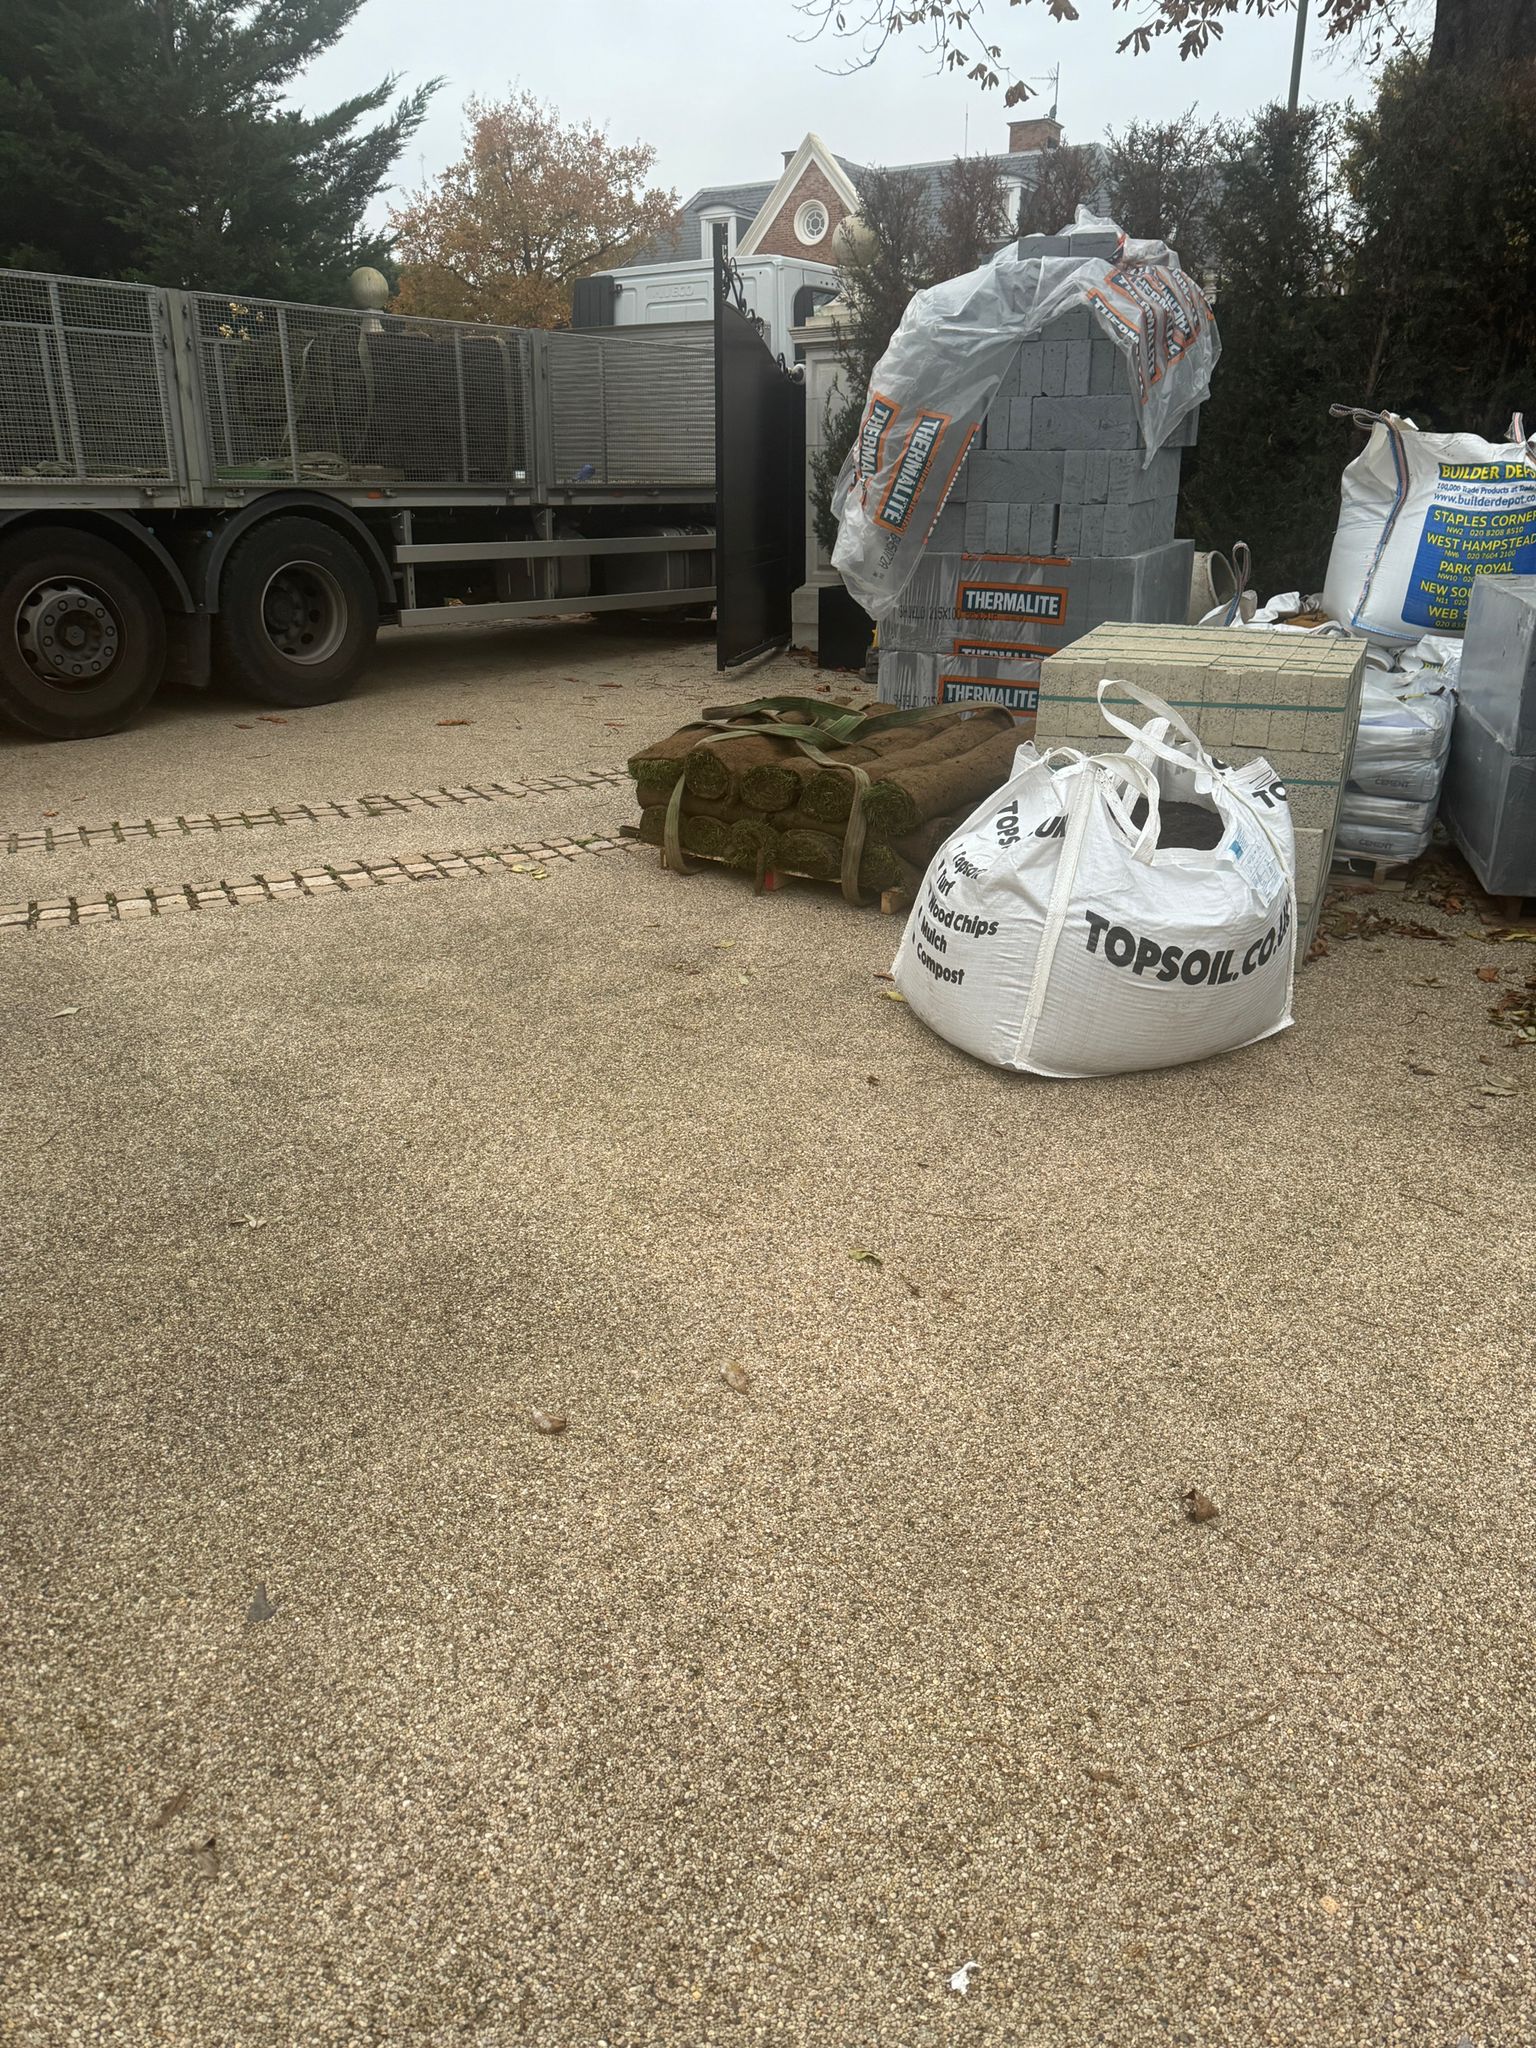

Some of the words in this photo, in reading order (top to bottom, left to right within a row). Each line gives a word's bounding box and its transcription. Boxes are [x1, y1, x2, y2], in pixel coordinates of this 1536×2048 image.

[883, 419, 941, 525] THERMALITE
[1441, 464, 1500, 480] BUILDER
[1462, 485, 1480, 494] Trade
[1480, 486, 1509, 495] Products
[1434, 509, 1488, 528] STAPLES
[1446, 526, 1463, 535] NW2
[1470, 529, 1484, 537] 020
[1427, 532, 1460, 550] WEST
[1467, 552, 1480, 560] 020
[1437, 572, 1458, 582] NW10
[1439, 560, 1473, 575] PARK
[1475, 561, 1515, 576] ROYAL
[1420, 580, 1449, 596] NEW
[965, 590, 1060, 616] THERMALITE
[1428, 604, 1459, 619] WEB
[946, 684, 1038, 709] THERMALITE
[937, 868, 956, 896] Turf
[921, 916, 947, 954] Mulch
[953, 914, 999, 939] Chips
[917, 943, 965, 986] Compost
